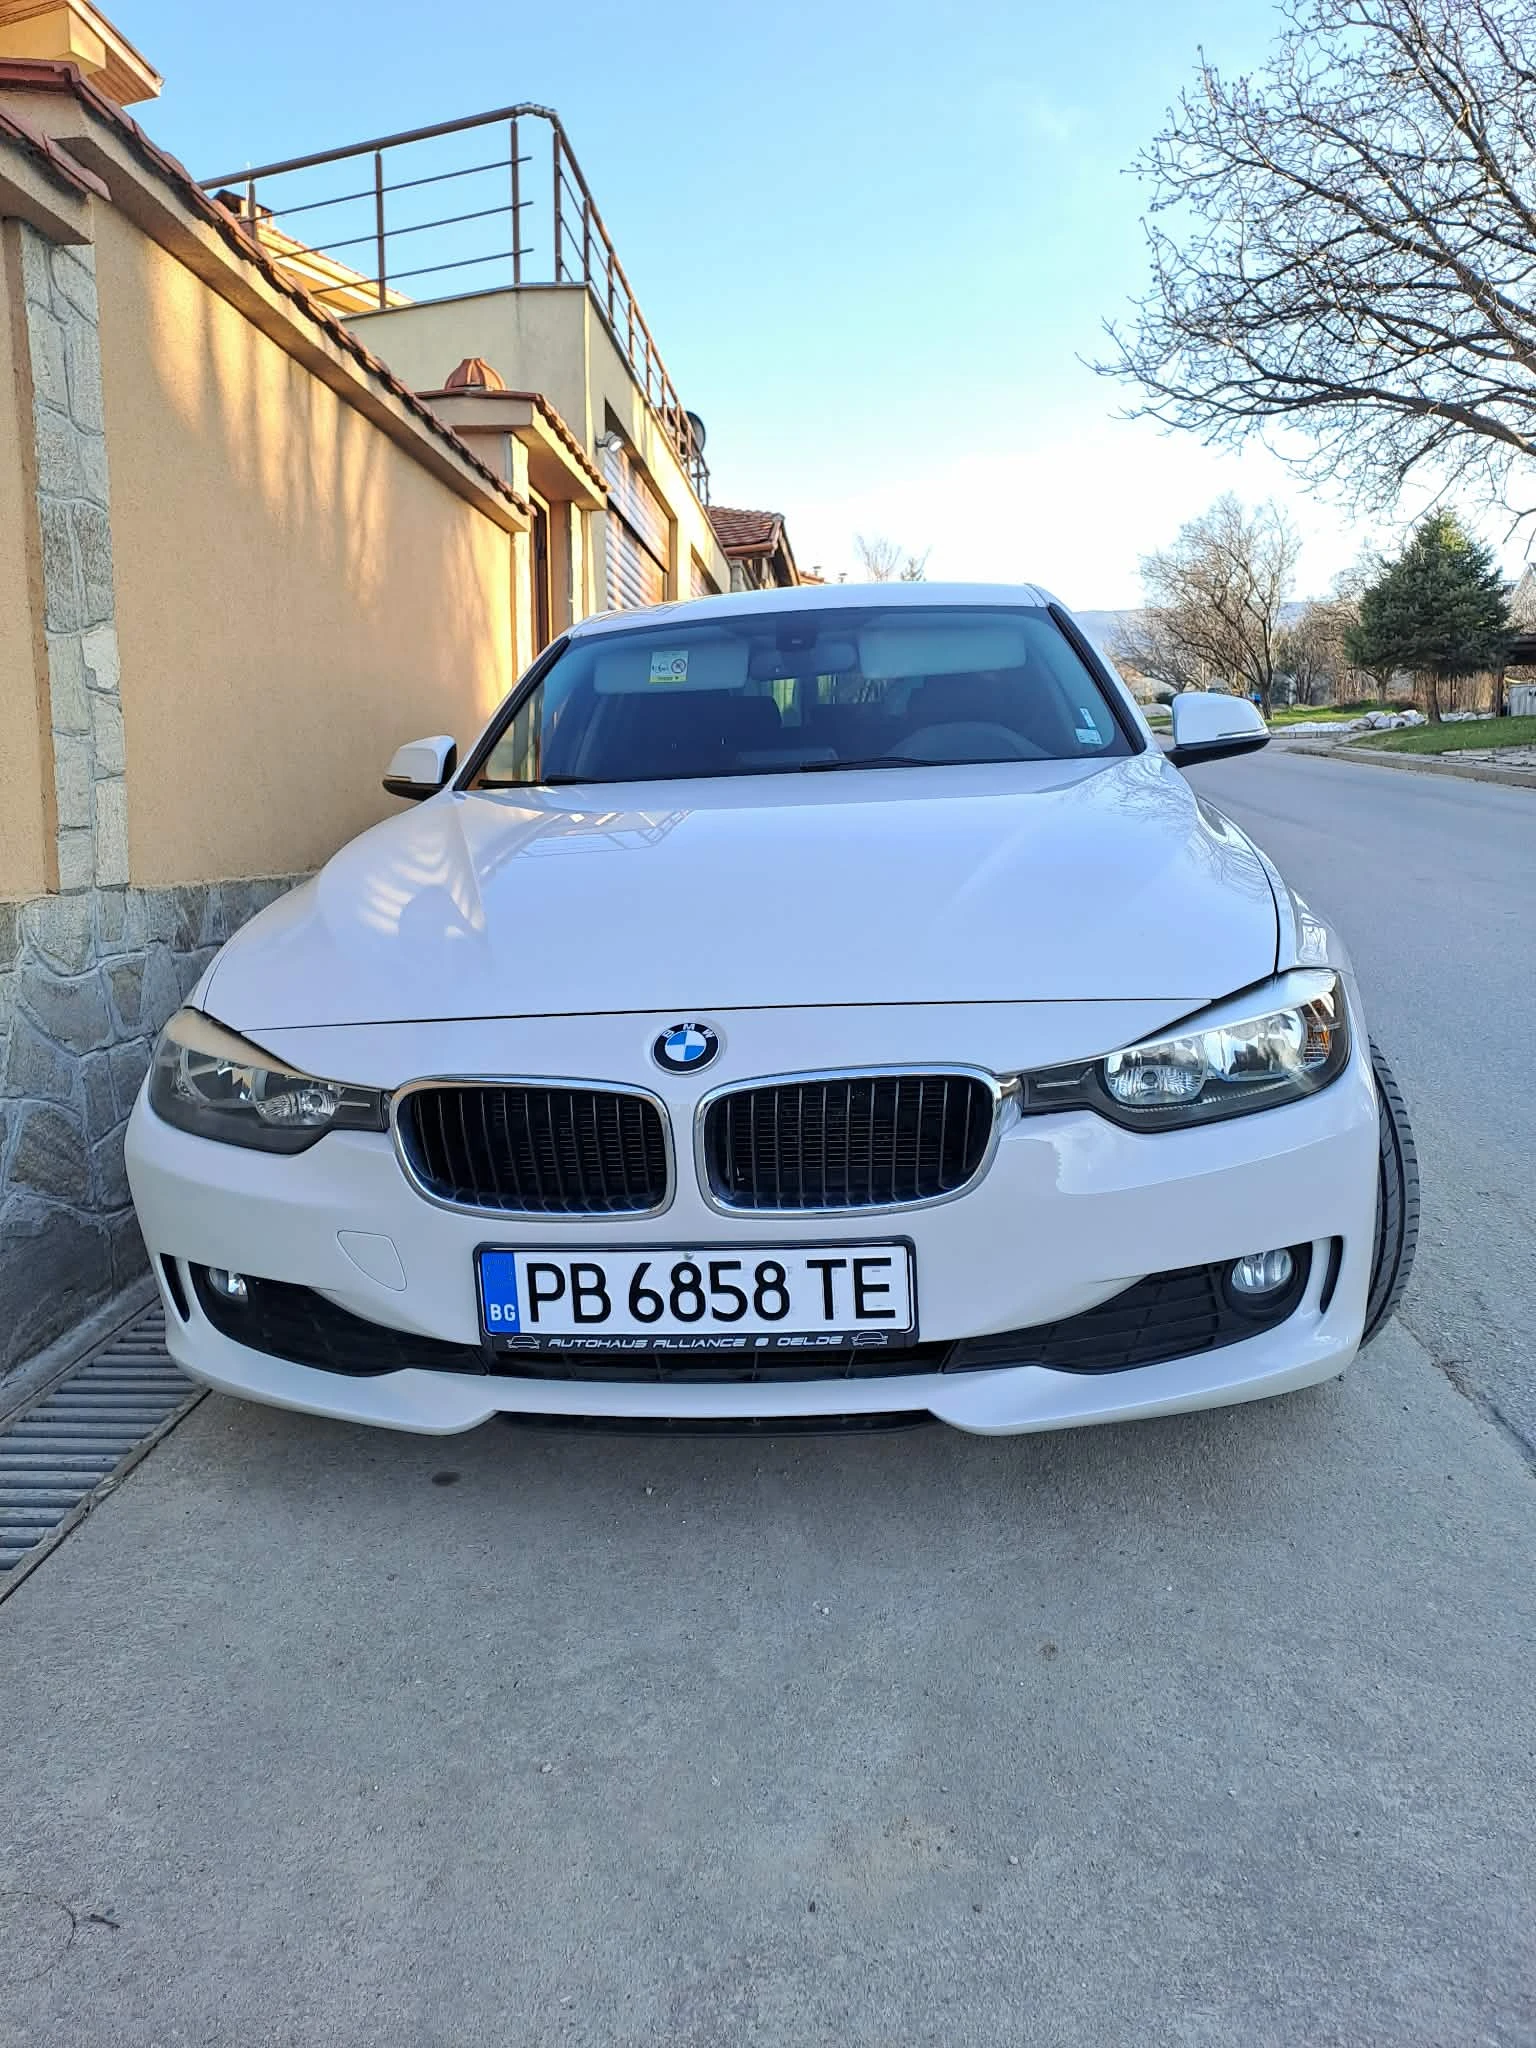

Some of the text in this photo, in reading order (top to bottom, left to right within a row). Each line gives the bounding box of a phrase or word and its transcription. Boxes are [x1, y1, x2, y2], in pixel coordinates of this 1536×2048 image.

[661, 1023, 716, 1038] BMW
[526, 1257, 896, 1324] PB 6858 TE
[490, 1303, 516, 1321] BG
[548, 1338, 649, 1349] AUTOHAUS
[652, 1338, 747, 1349] ALLIANCE
[776, 1335, 844, 1347] OELDE
